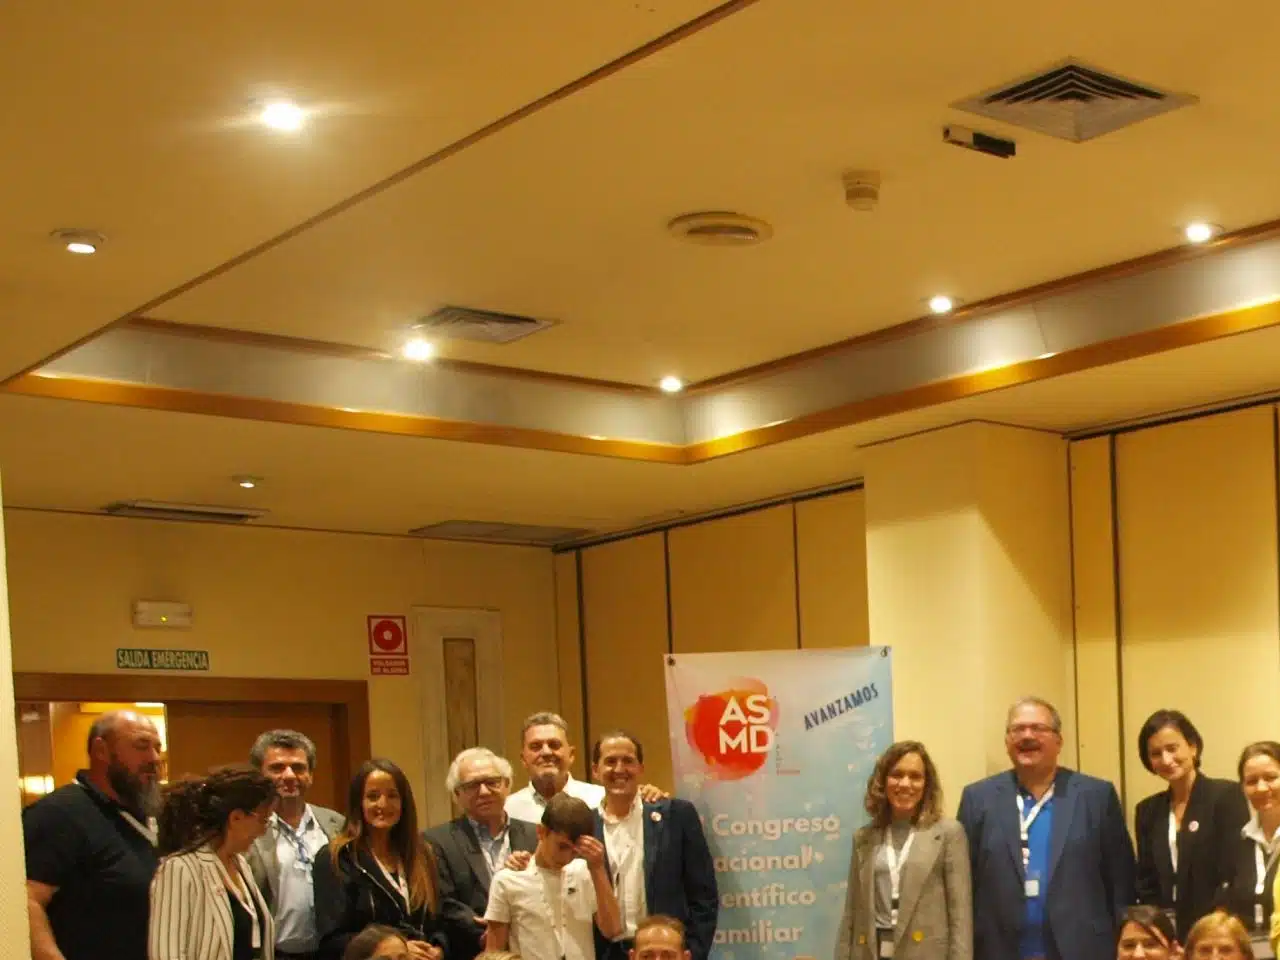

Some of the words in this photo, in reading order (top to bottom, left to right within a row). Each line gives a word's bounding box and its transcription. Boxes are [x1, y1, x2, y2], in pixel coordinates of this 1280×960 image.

[118, 650, 150, 667] SALIDA
[719, 694, 771, 725] AS
[803, 682, 879, 731] AVANZAMOS
[718, 725, 776, 754] MD
[712, 813, 841, 841] Congreso
[713, 844, 813, 872] acional
[719, 882, 816, 908] entífico
[713, 919, 804, 944] amiliar
